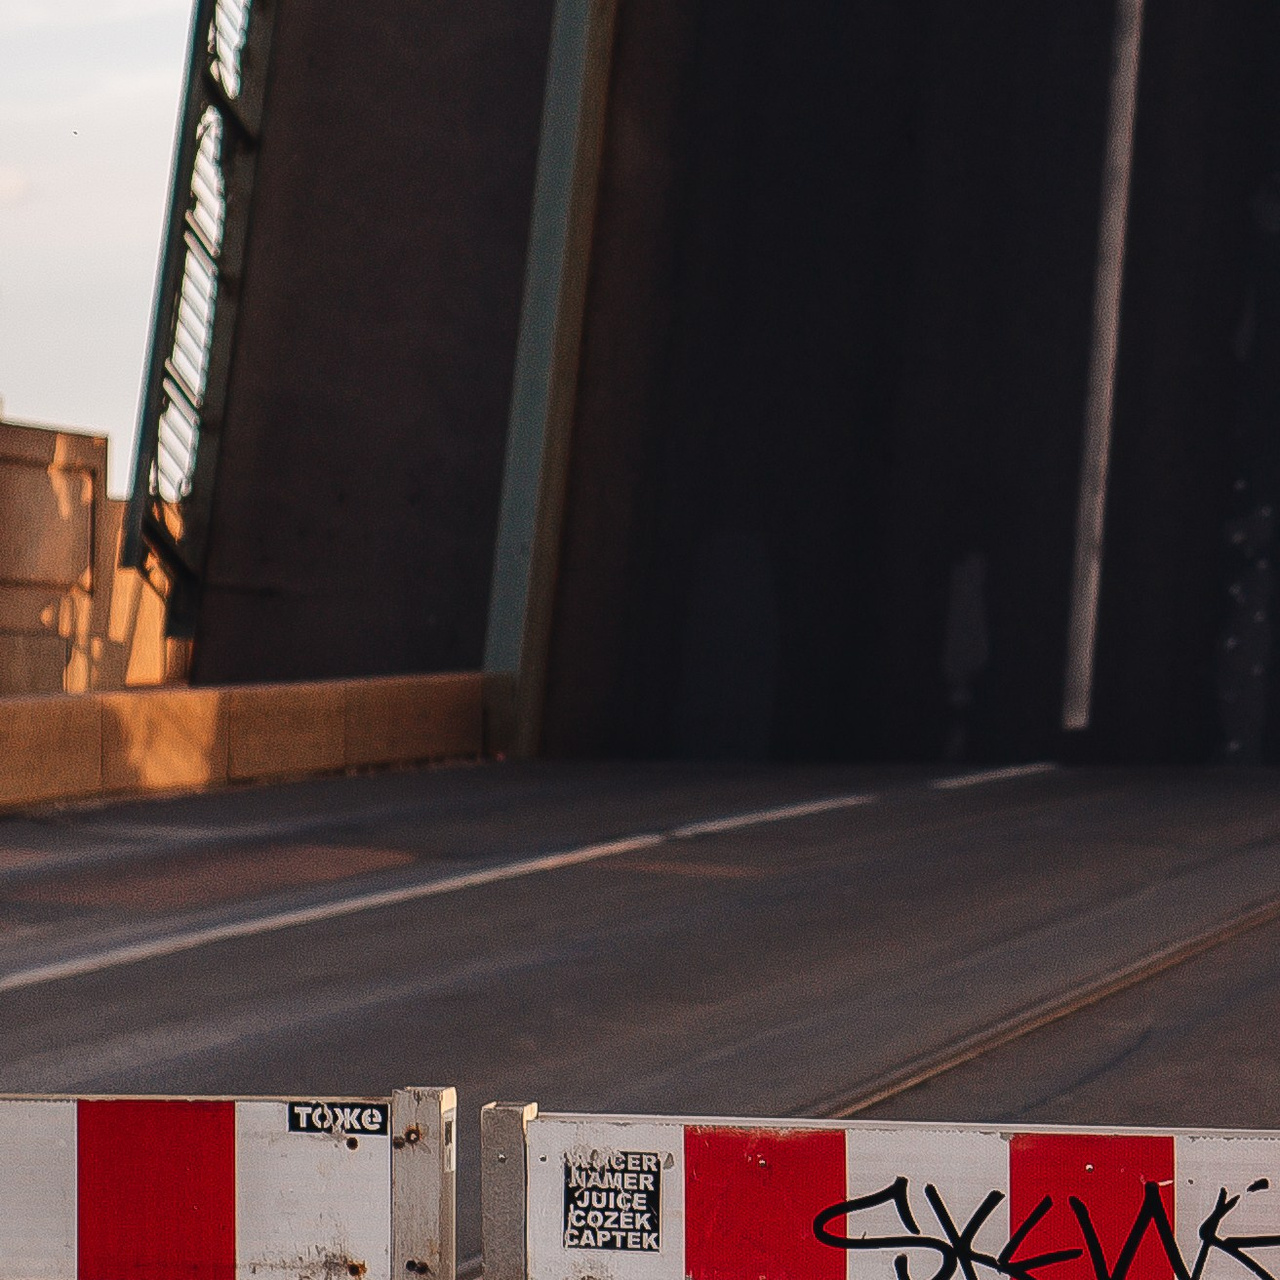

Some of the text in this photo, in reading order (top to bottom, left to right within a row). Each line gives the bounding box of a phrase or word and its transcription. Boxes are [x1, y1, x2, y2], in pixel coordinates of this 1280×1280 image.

[569, 1170, 654, 1191] NAMER
[576, 1191, 647, 1211] JUICE
[570, 1209, 652, 1231] COZEK
[565, 1228, 659, 1250] CAPTEK
